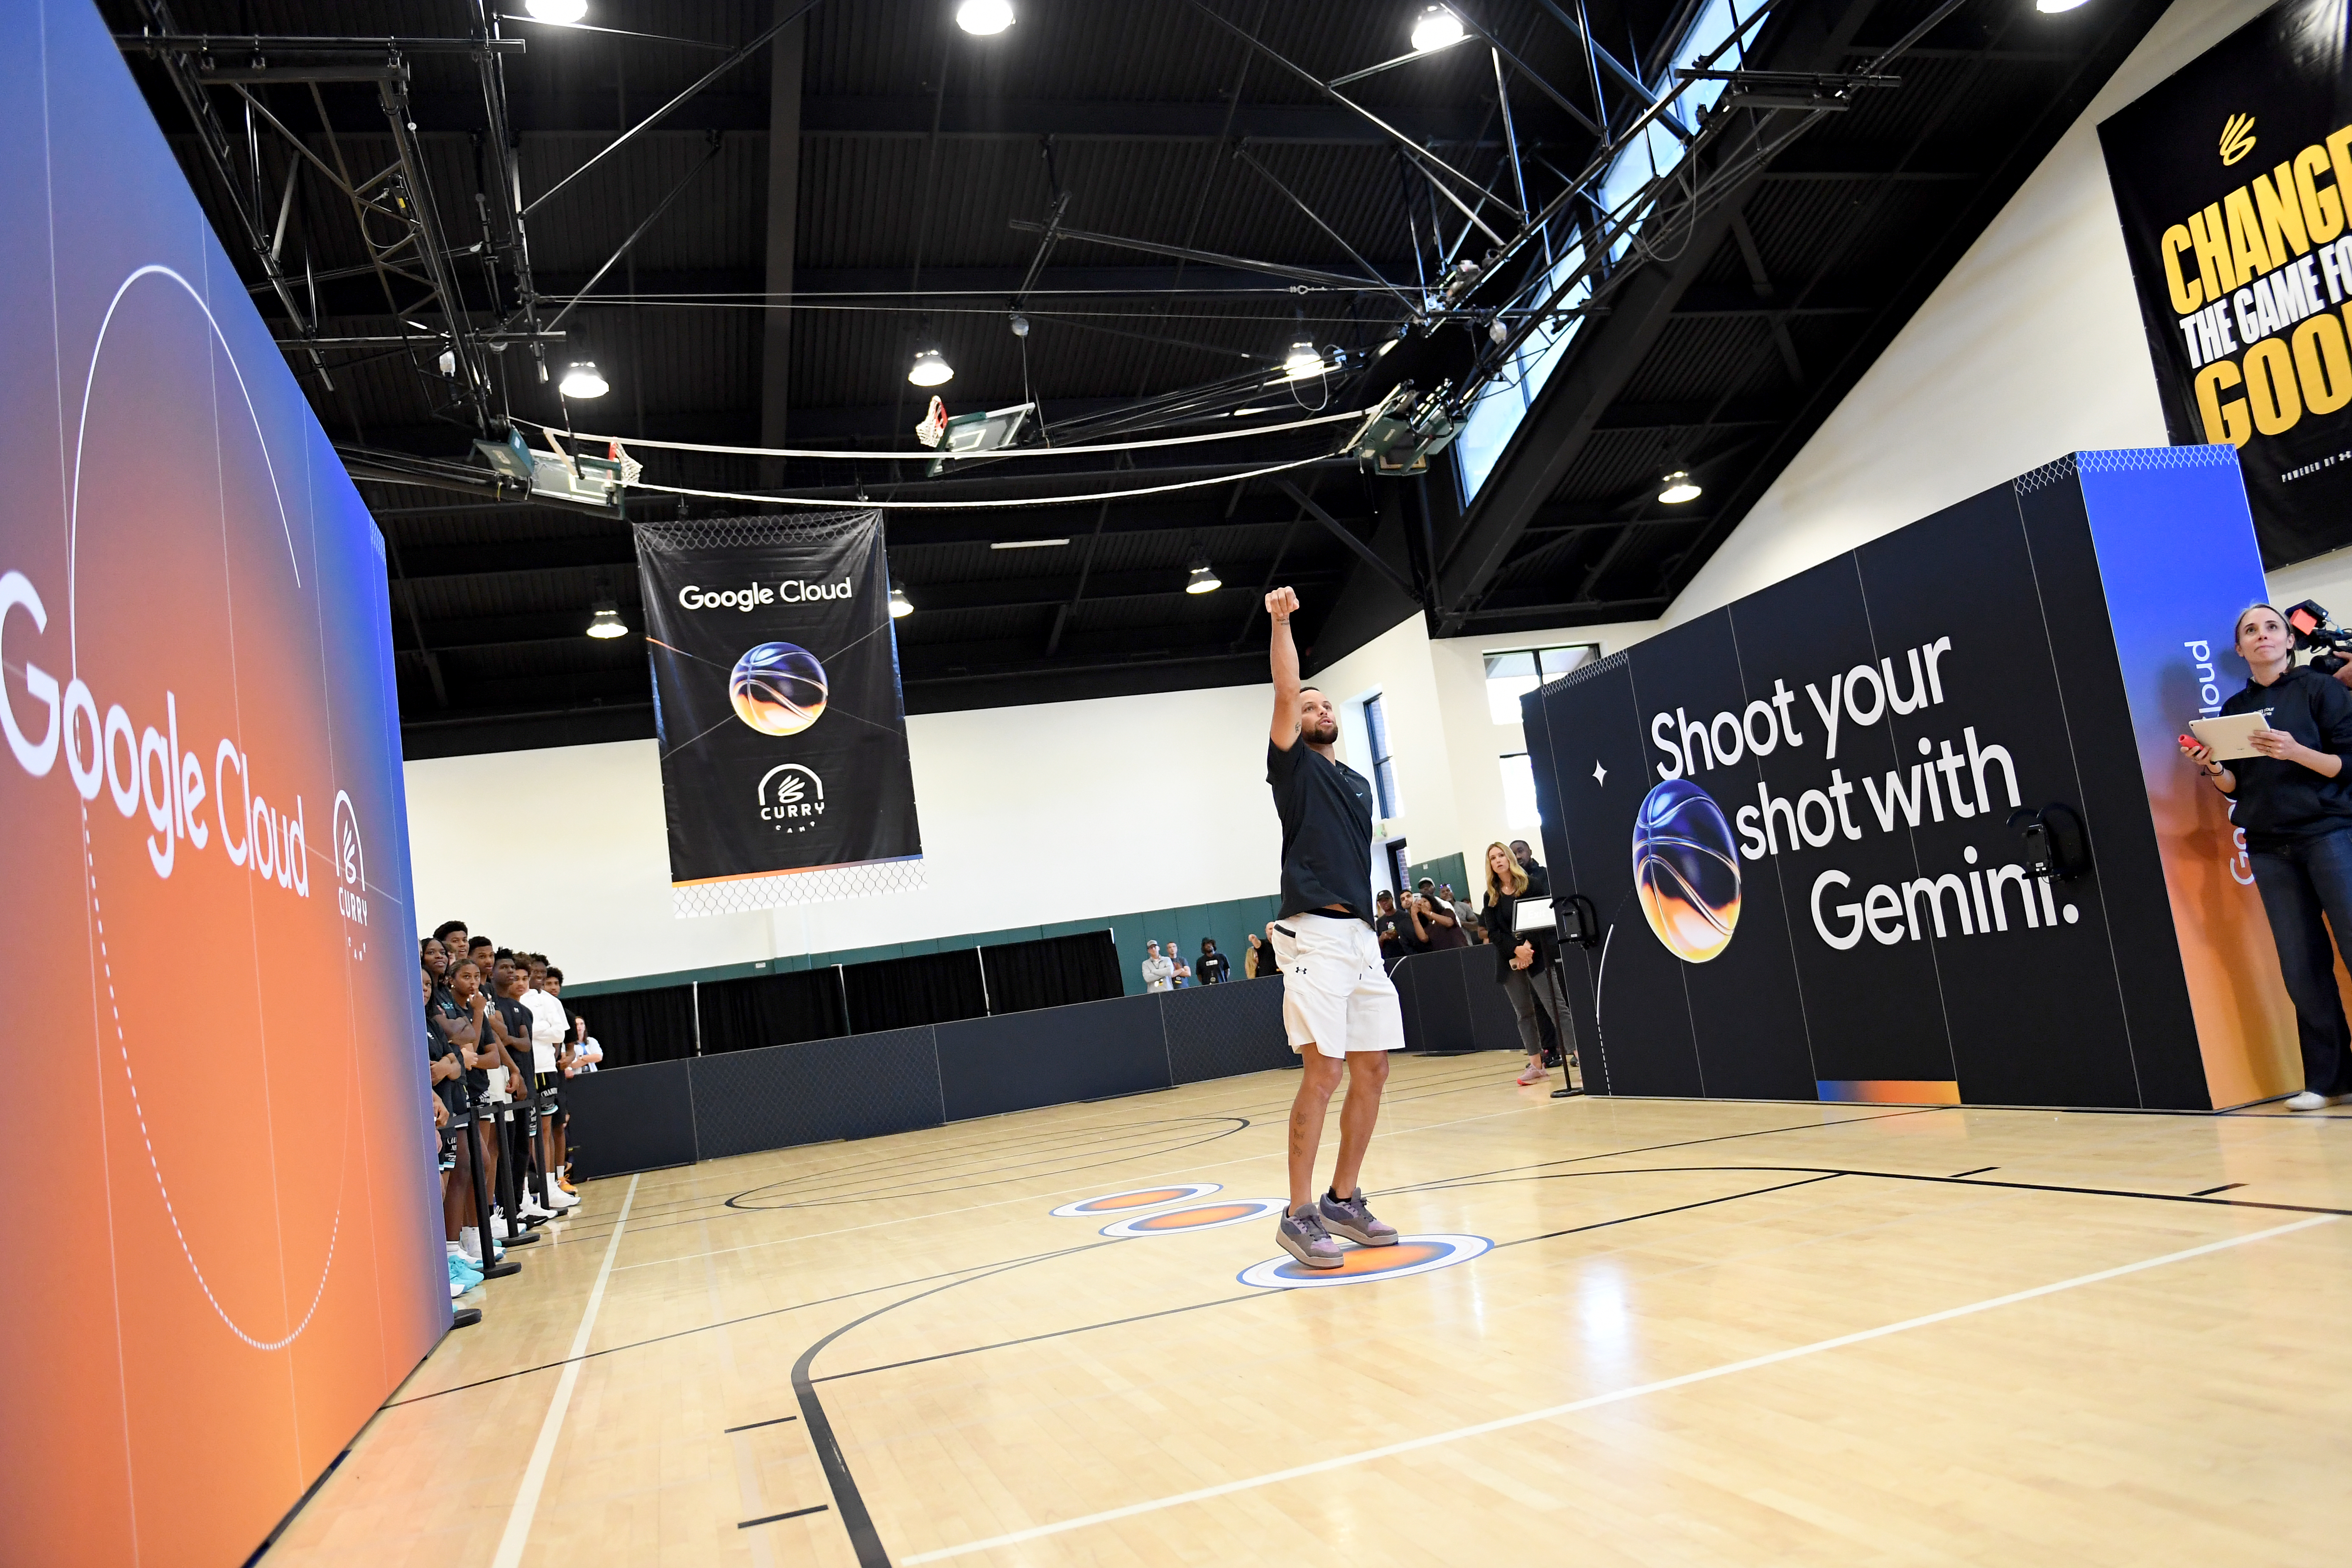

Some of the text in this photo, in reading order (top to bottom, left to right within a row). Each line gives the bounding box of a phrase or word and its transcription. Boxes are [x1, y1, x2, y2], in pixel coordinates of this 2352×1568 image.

[2179, 298, 2238, 369] THE
[2233, 254, 2325, 344] GAME
[2194, 300, 2352, 449] GOO
[2281, 456, 2335, 482] POWERED BY
[679, 577, 852, 612] Google Cloud
[1651, 636, 1952, 781] Shoot your
[2184, 640, 2222, 719] loud
[0, 570, 309, 897] Google Cloud
[761, 802, 825, 820] CURRY
[776, 821, 815, 833] CAMP
[1736, 726, 2021, 861] shot with
[339, 887, 367, 926] CURRY
[1528, 909, 1546, 919] Exit
[1811, 846, 2079, 950] Gemini.
